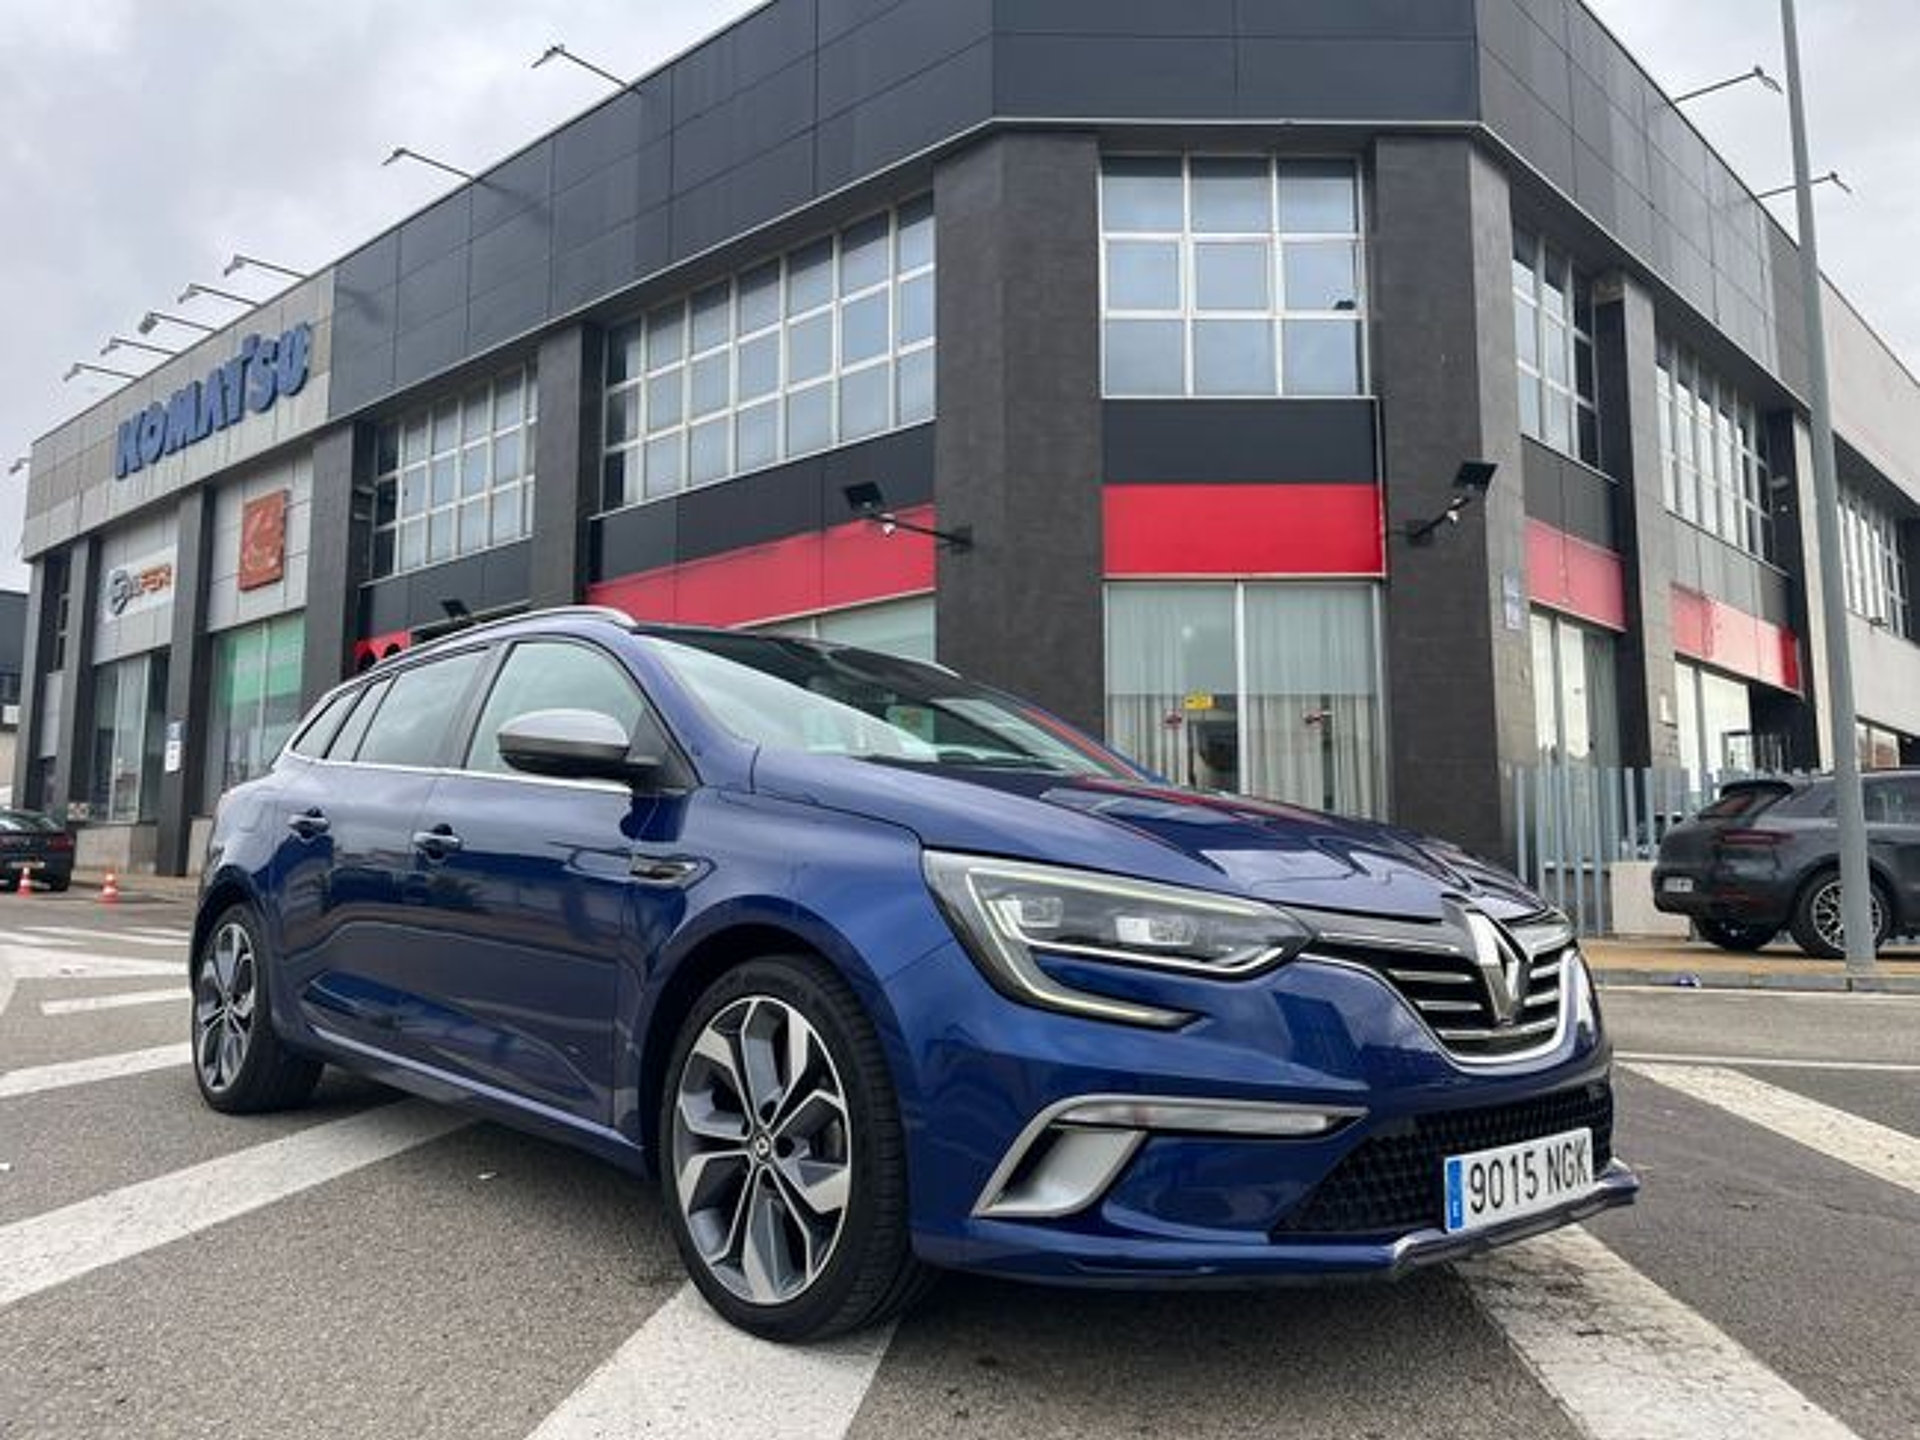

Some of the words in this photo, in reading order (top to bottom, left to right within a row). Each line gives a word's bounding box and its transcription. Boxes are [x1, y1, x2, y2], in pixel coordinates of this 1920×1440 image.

[115, 323, 311, 480] KOMATSU
[1470, 1151, 1539, 1214] 9015
[1547, 1138, 1589, 1195] NGK
